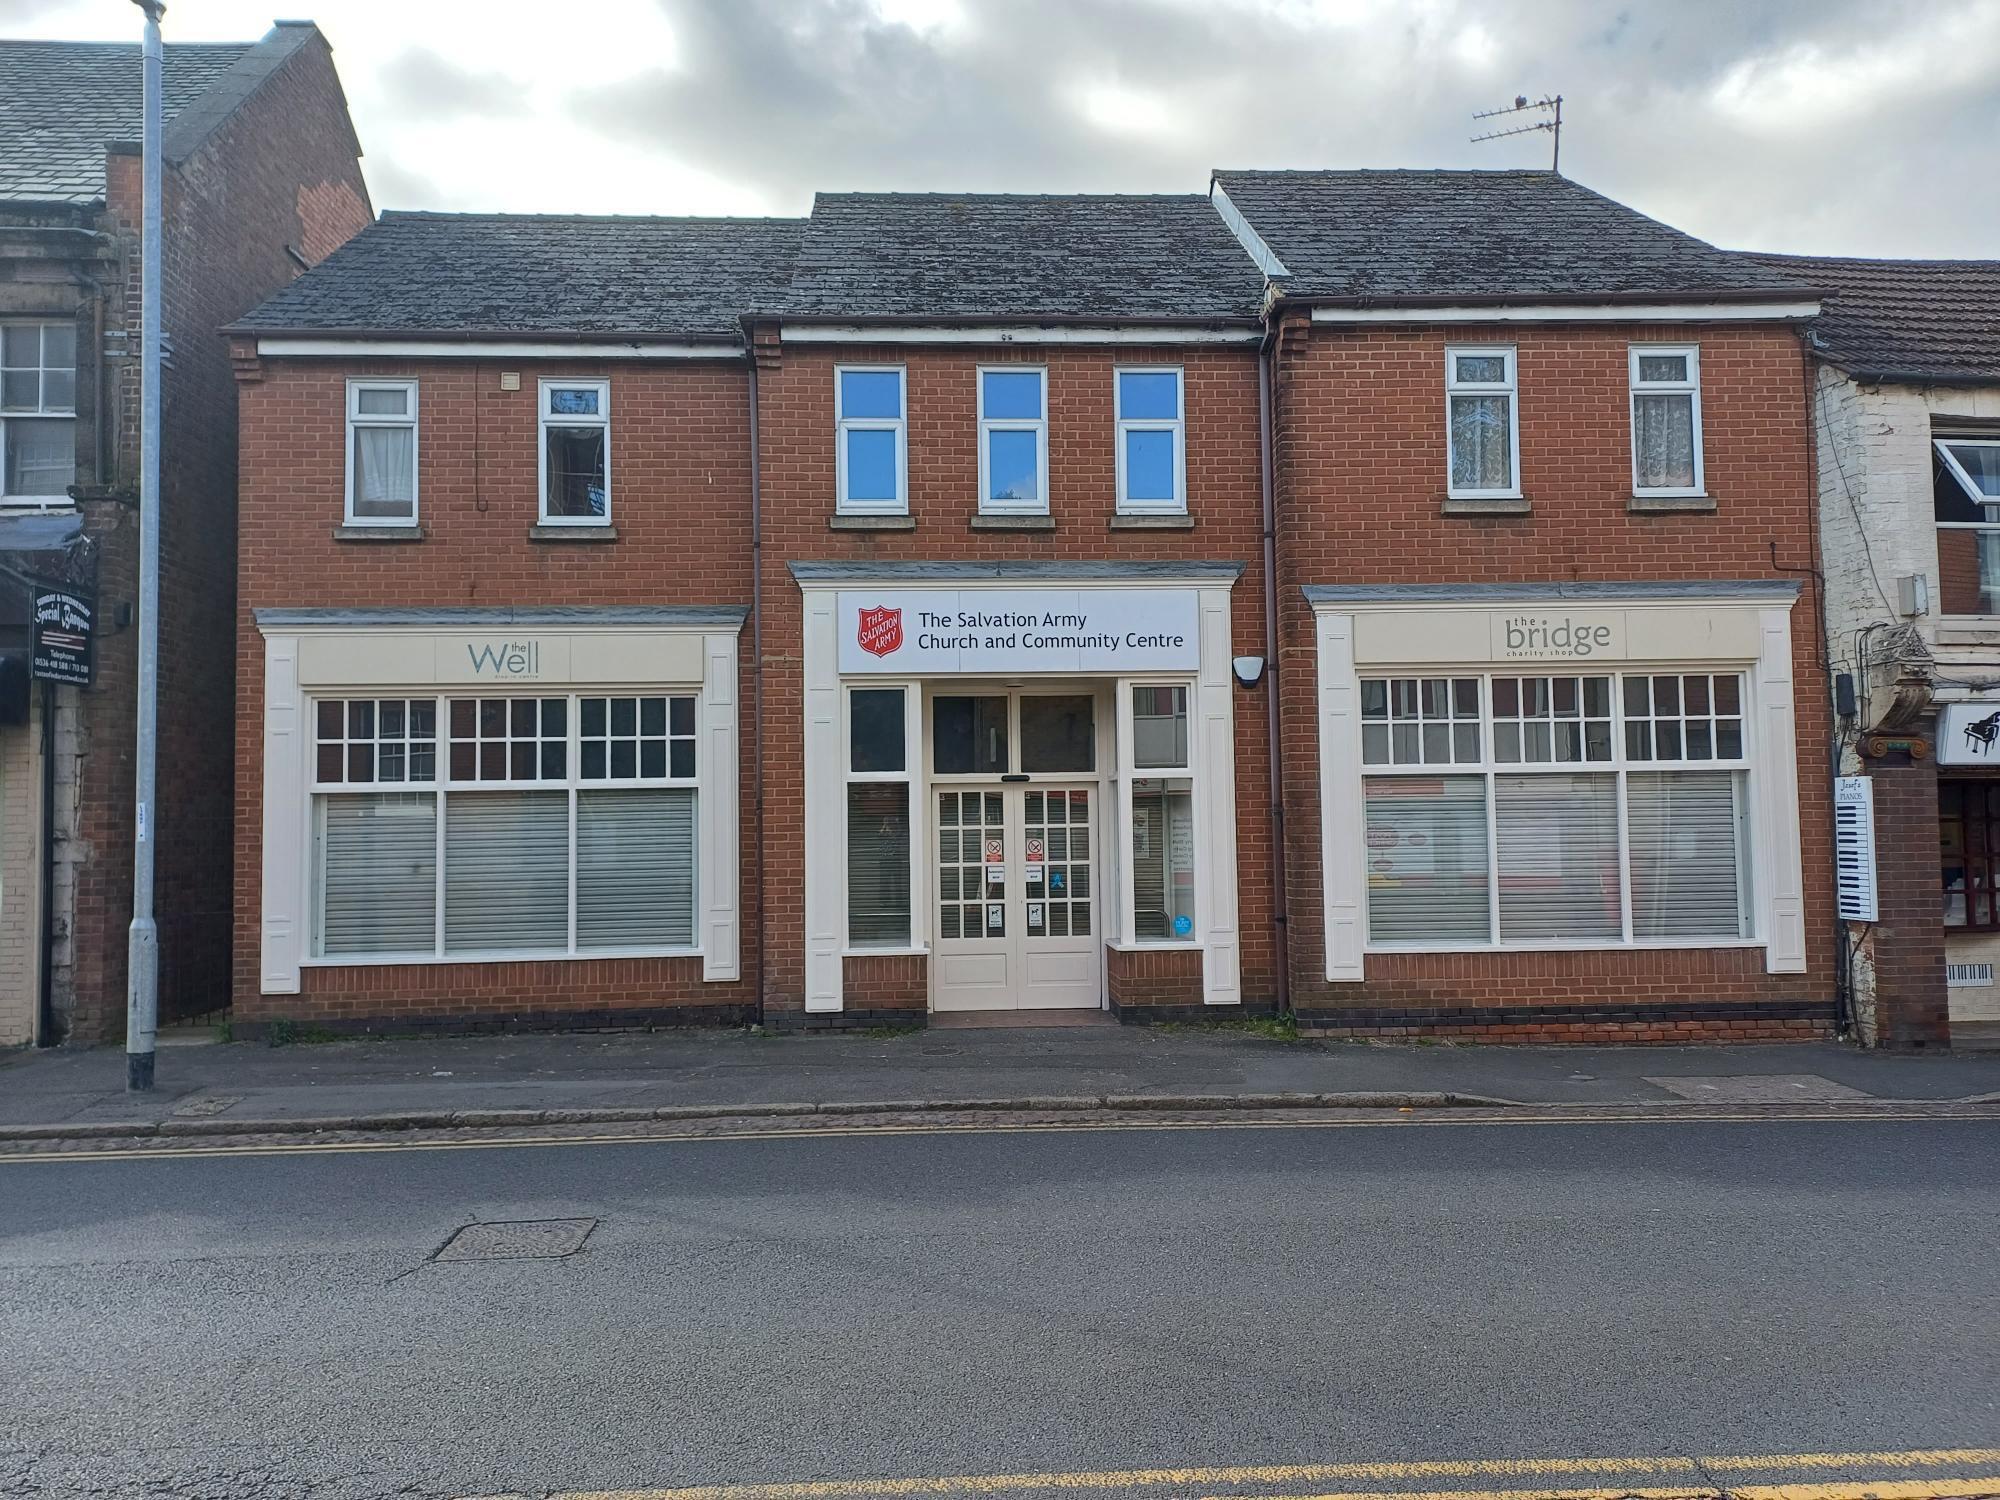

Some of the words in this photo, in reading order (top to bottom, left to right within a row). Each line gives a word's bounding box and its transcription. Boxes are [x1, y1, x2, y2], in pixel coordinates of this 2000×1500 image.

[56, 593, 61, 602] &
[34, 602, 60, 624] Special
[866, 611, 884, 628] THE
[918, 612, 952, 628] The
[957, 612, 1037, 627] Salvation
[1042, 612, 1087, 630] Army
[1514, 617, 1536, 626] the
[861, 613, 897, 644] SALVATION
[1505, 618, 1611, 656] bridge
[511, 642, 526, 652] the
[874, 628, 897, 650] ARMY
[918, 633, 979, 649] Church
[985, 632, 1016, 648] and
[1022, 632, 1120, 652] Community
[1126, 632, 1184, 648] Centre
[50, 649, 75, 661] Telephone
[467, 641, 539, 674] Well
[1840, 793, 1863, 801] PIANOS
